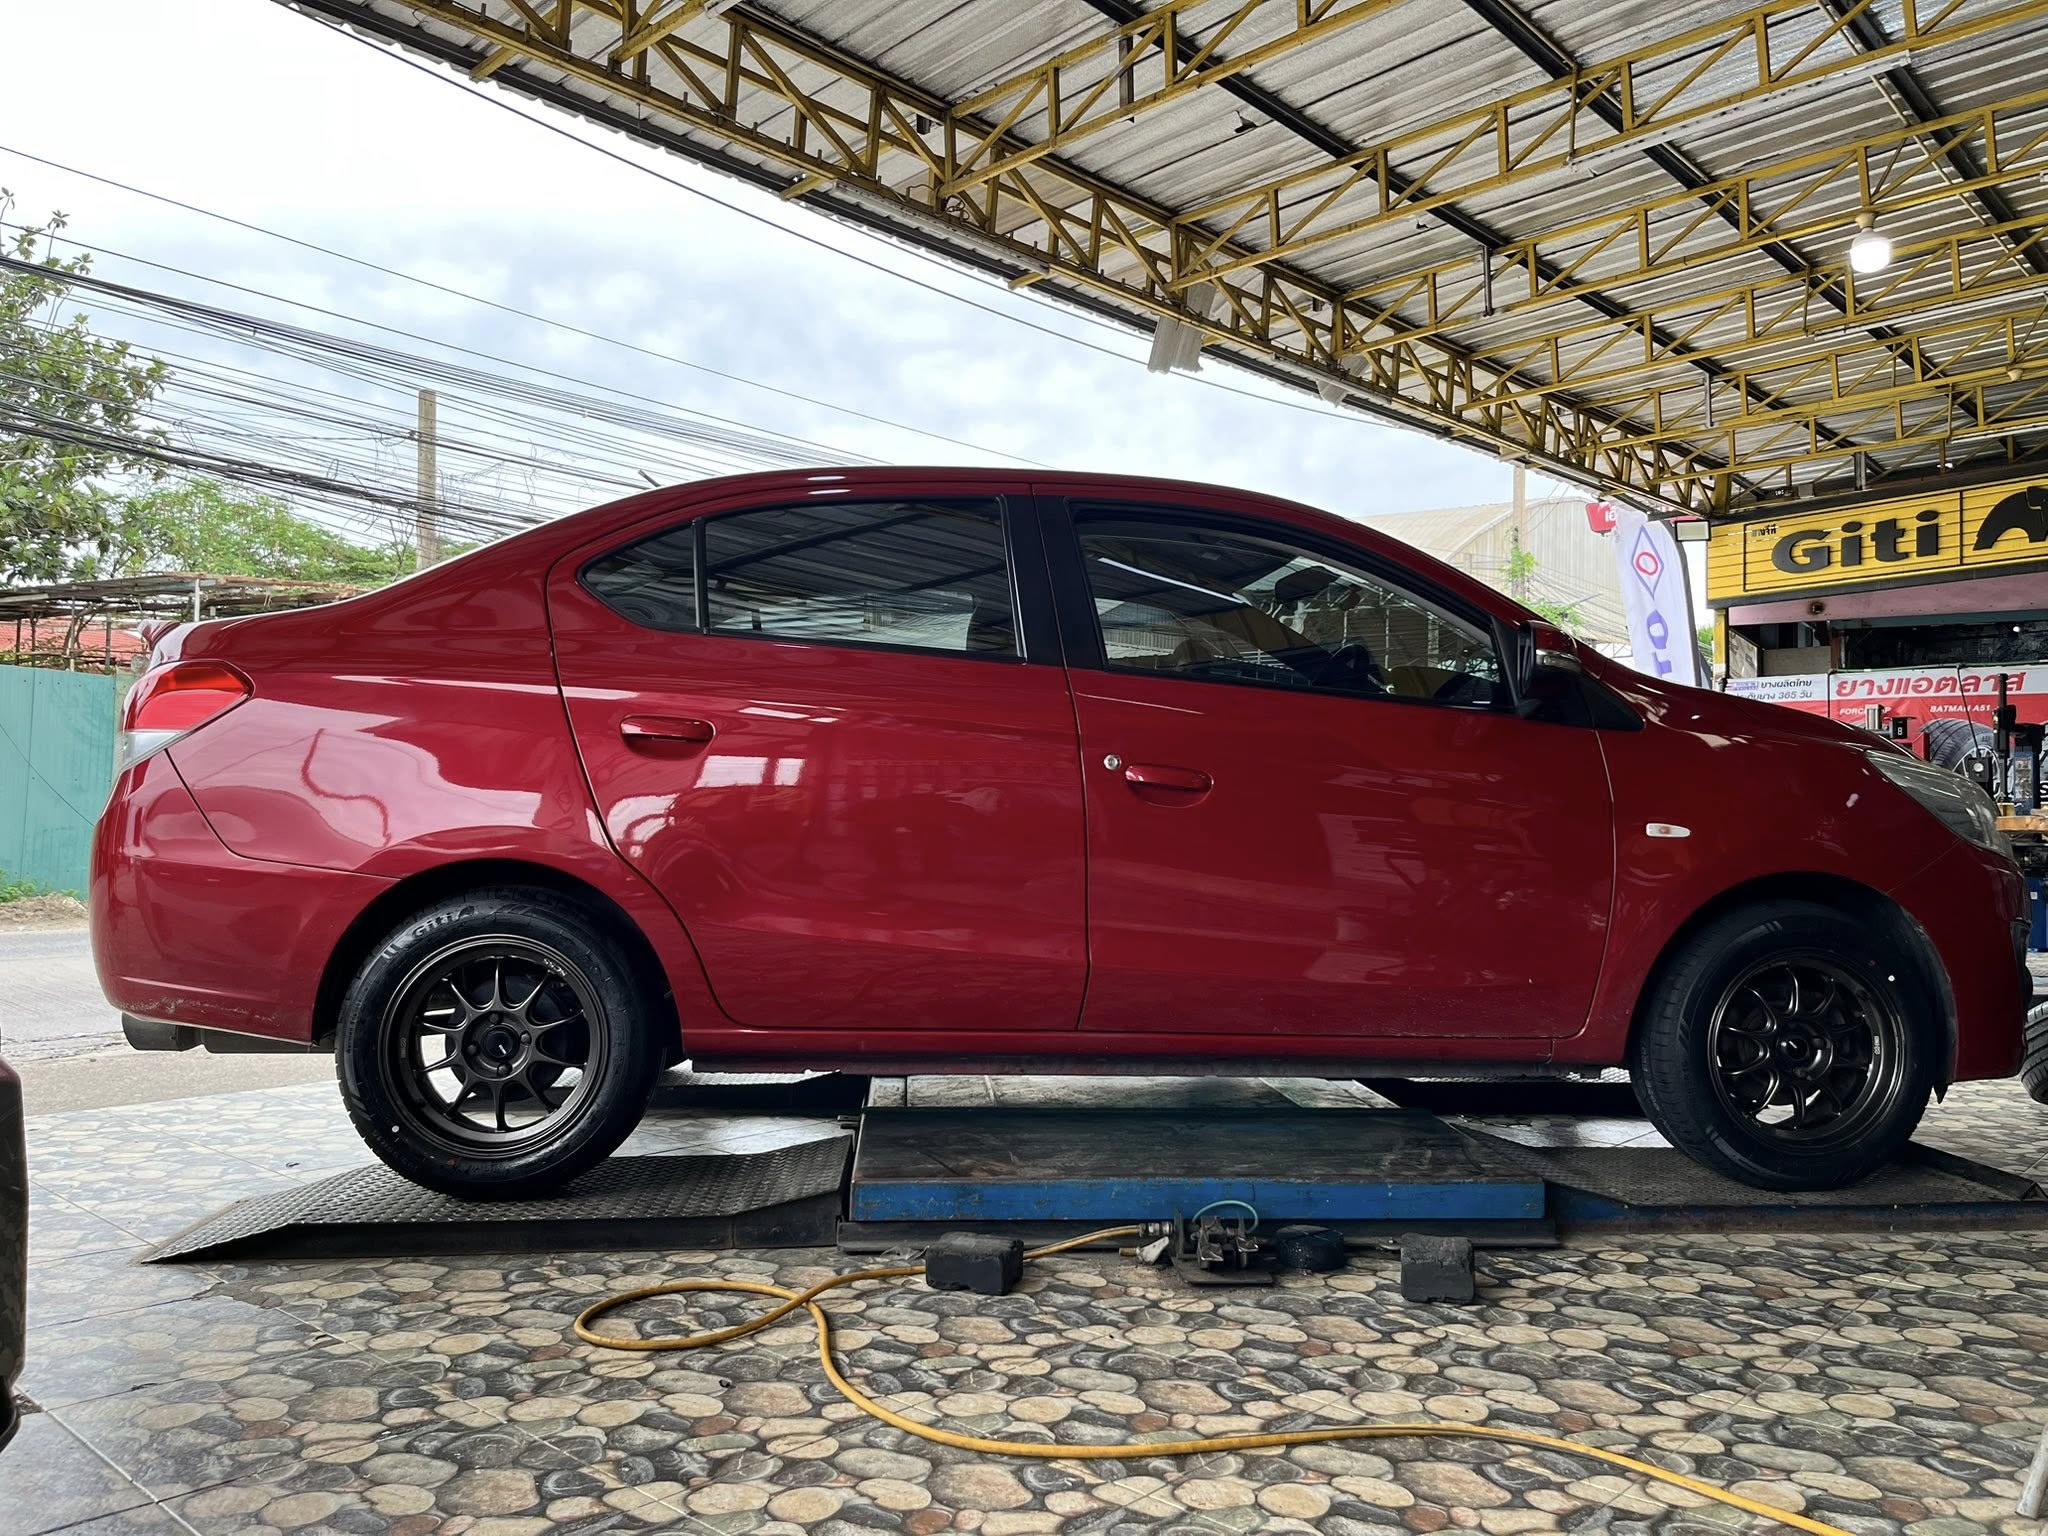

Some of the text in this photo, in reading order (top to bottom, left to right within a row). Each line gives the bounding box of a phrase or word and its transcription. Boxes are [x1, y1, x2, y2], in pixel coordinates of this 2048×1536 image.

[1771, 509, 1940, 574] Giti
[1778, 690, 1797, 700] 365
[1799, 689, 1813, 699] วัน
[1972, 704, 1991, 712] A51
